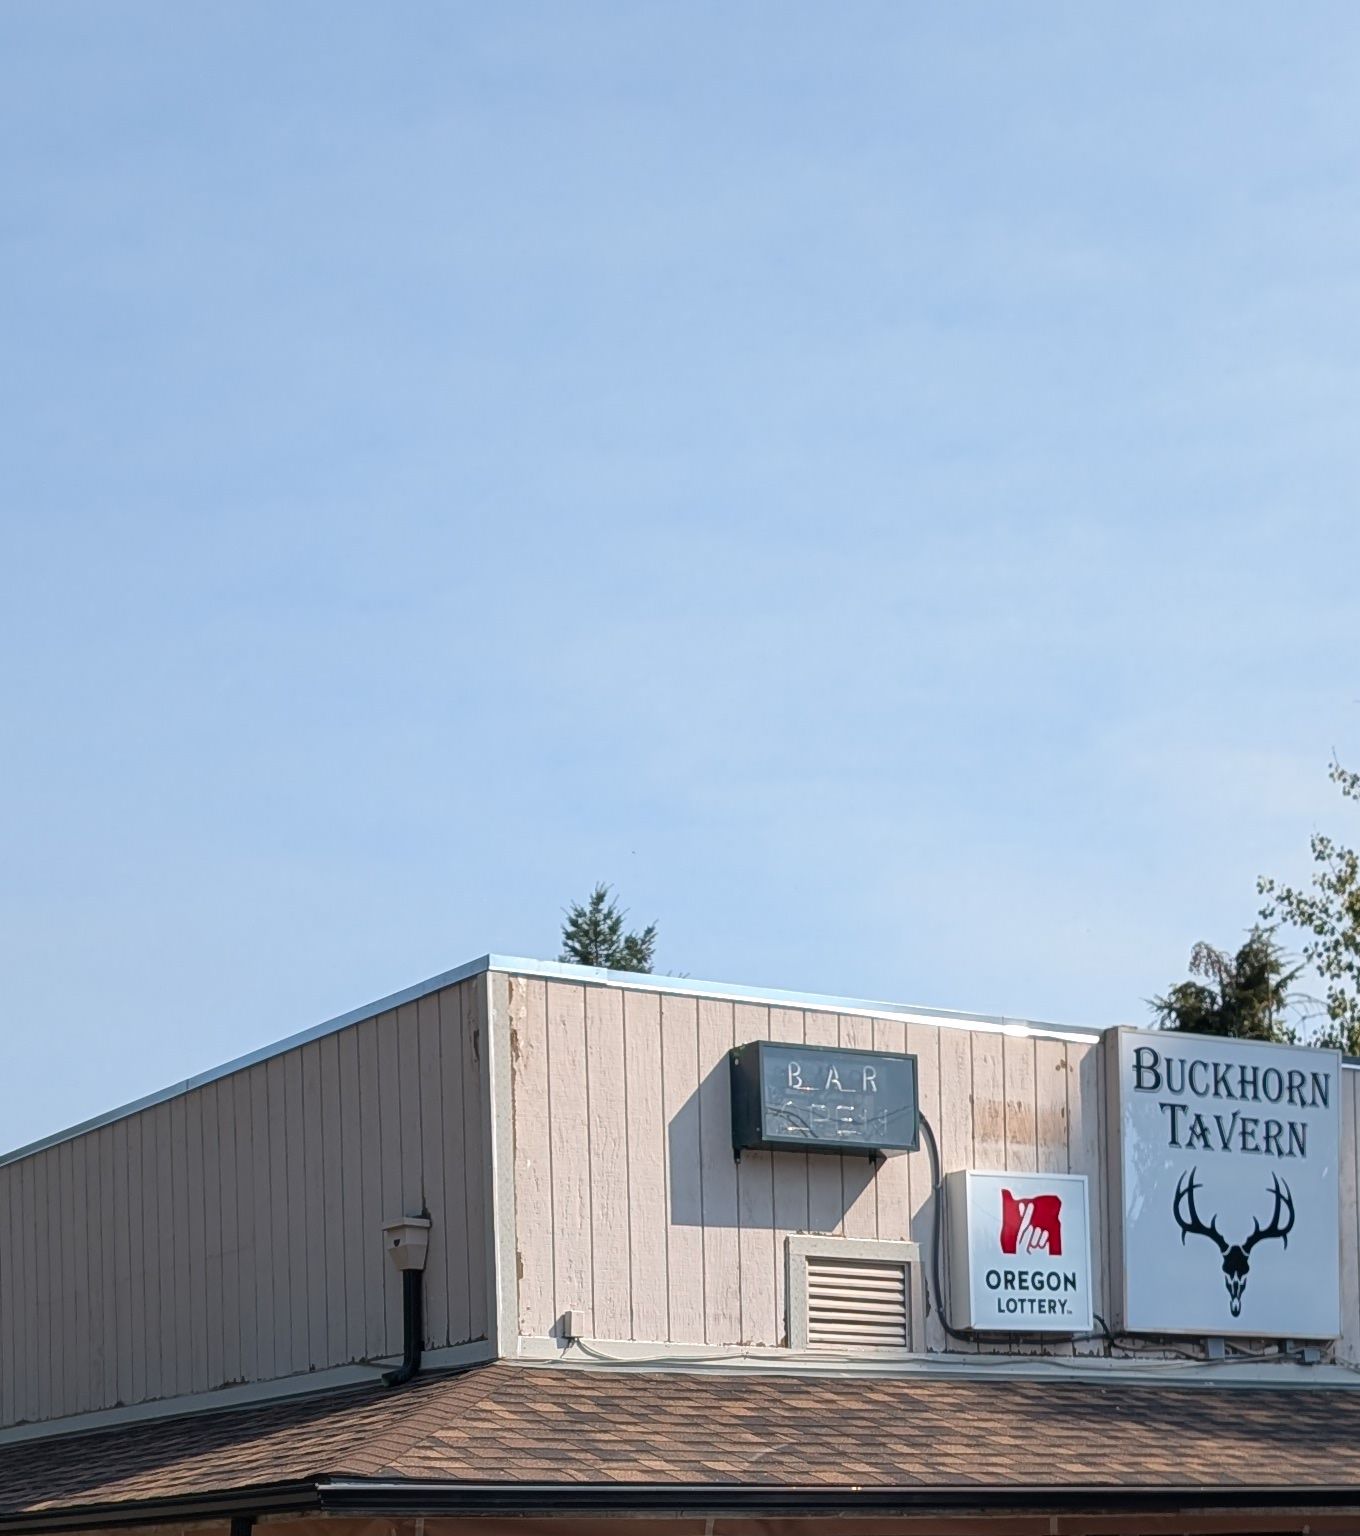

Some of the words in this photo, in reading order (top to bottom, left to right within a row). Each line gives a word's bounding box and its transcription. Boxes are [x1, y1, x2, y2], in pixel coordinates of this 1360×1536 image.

[787, 1061, 878, 1093] BAR
[1132, 1046, 1331, 1109] BUCKHORN
[1158, 1101, 1308, 1159] TAVERN
[985, 1269, 1077, 1292] OREGON
[997, 1297, 1068, 1315] LOTTERY
